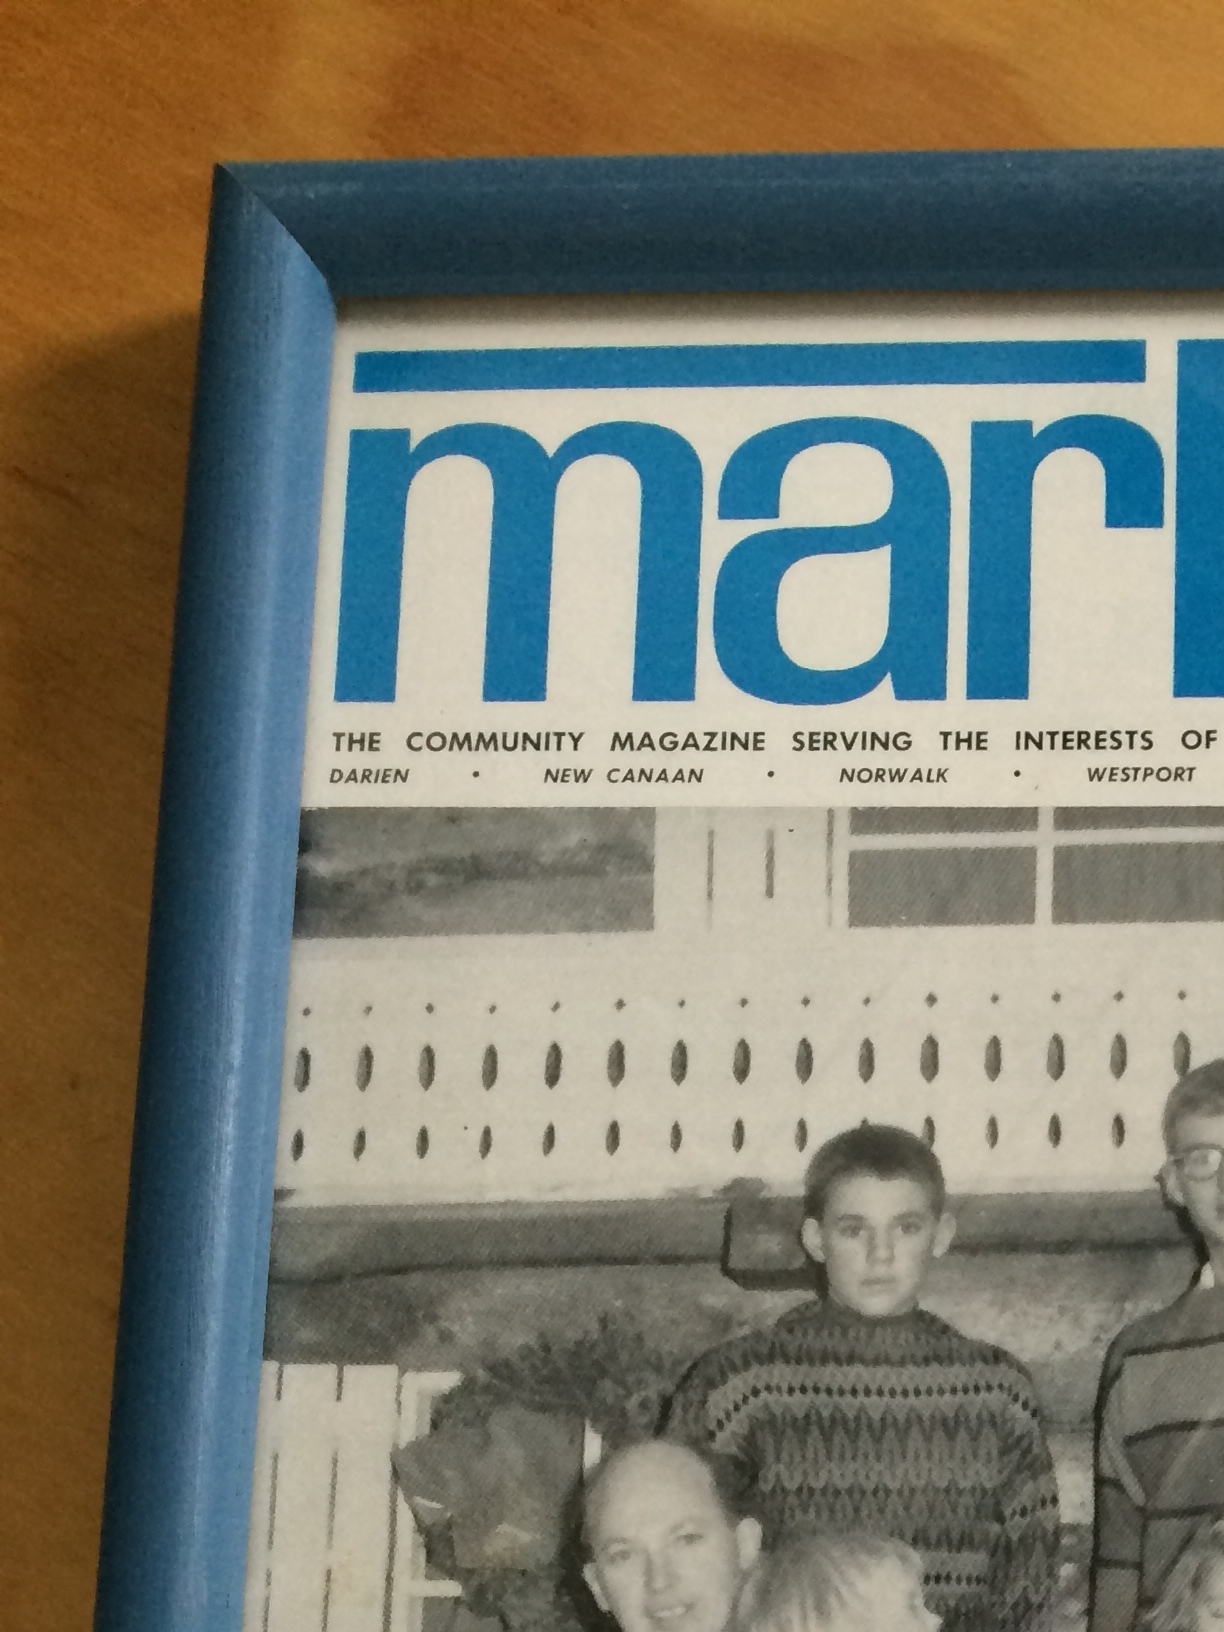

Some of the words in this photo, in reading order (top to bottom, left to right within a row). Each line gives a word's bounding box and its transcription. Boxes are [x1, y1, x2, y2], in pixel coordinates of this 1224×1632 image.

[332, 731, 382, 753] THE
[405, 731, 585, 752] COMMUNITY
[610, 731, 766, 752] MAGAZINE
[792, 730, 913, 752] SERVING
[939, 730, 989, 751] THE
[1015, 729, 1154, 751] INTERESTS
[1180, 729, 1218, 750] OF
[329, 768, 410, 784] DARIEN
[543, 768, 594, 784] NEW
[606, 767, 704, 784] CANAAN
[839, 767, 949, 784] NORWALK
[1087, 766, 1197, 783] WESTPORT
